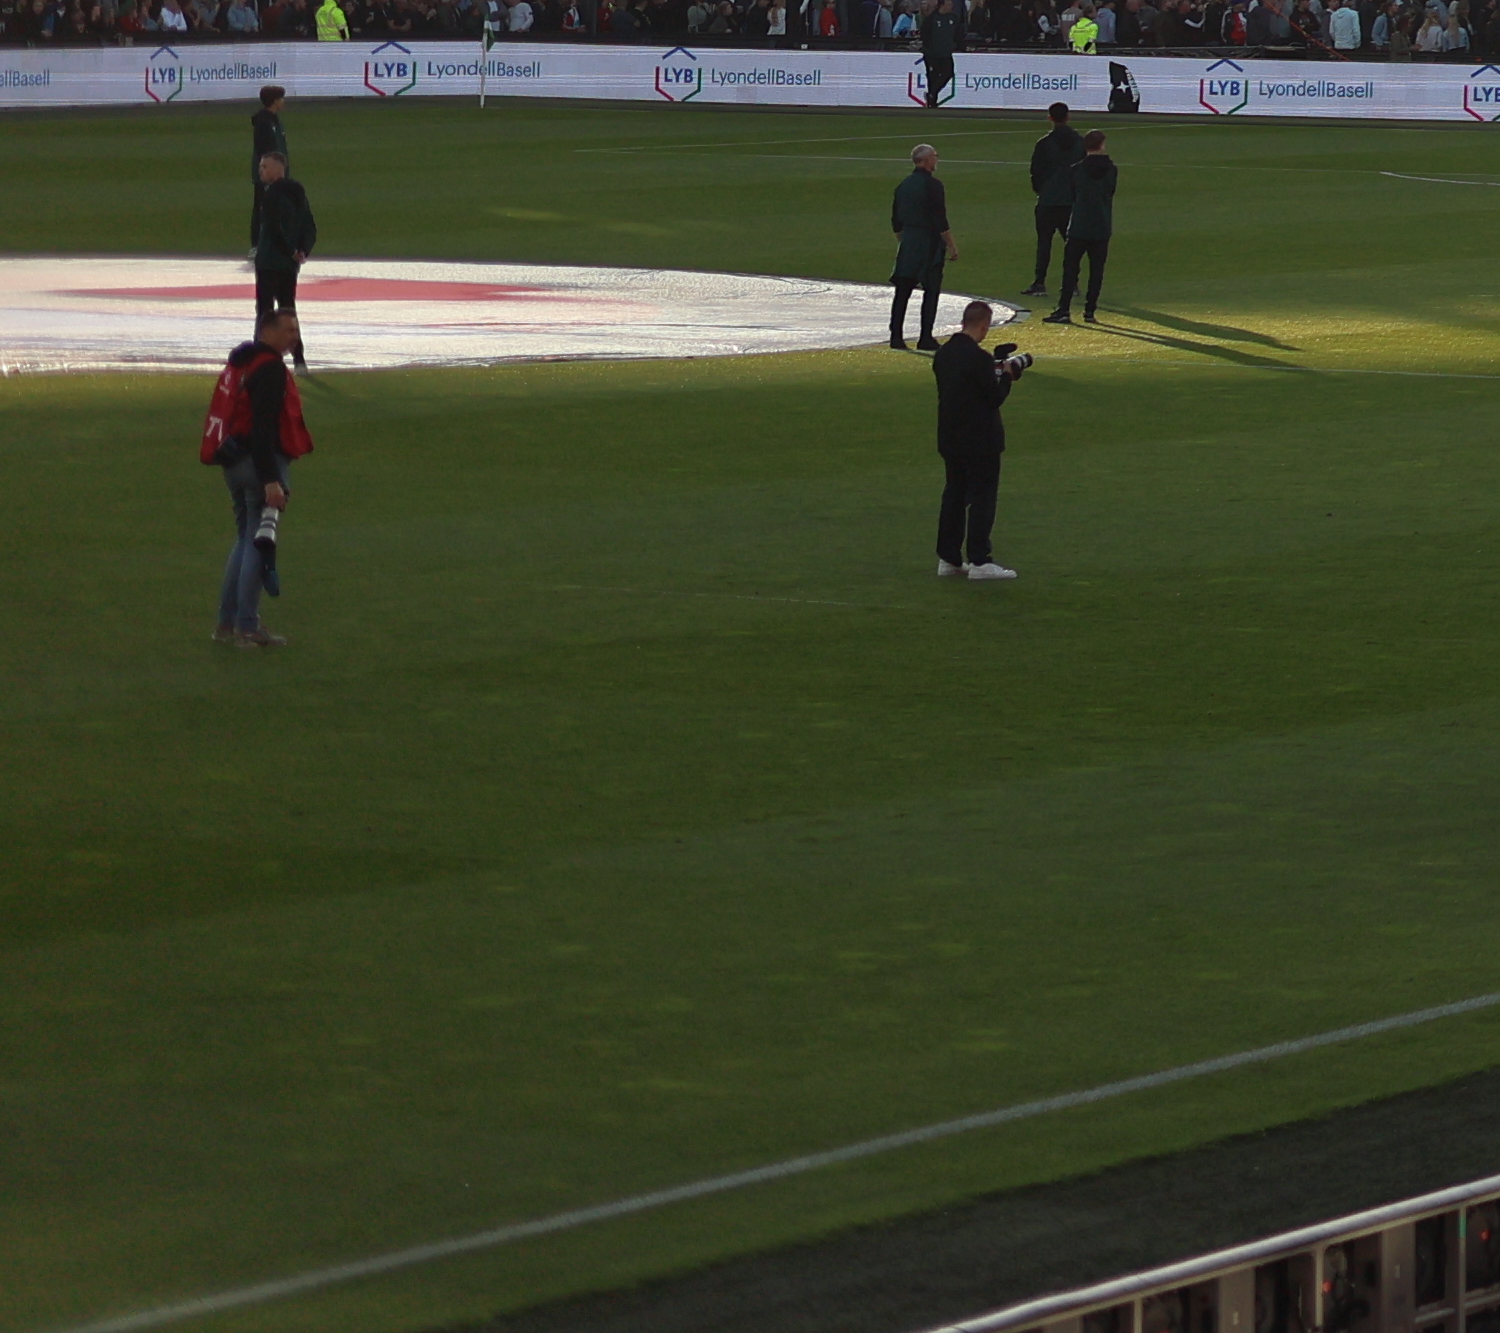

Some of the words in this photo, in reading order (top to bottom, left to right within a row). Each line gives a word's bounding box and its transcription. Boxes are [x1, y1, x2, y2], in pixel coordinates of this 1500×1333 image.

[0, 69, 50, 88] ellBasell
[151, 66, 177, 84] LYB
[189, 61, 277, 84] LyondellBasell
[373, 61, 408, 79] LYB
[426, 60, 542, 82] LyondellBasell
[663, 67, 694, 85] LYB
[710, 67, 821, 89] LyondellBasell
[964, 72, 1078, 94] LyondellBasell
[1209, 80, 1241, 98] LYB
[1258, 79, 1374, 101] LyondellBasell
